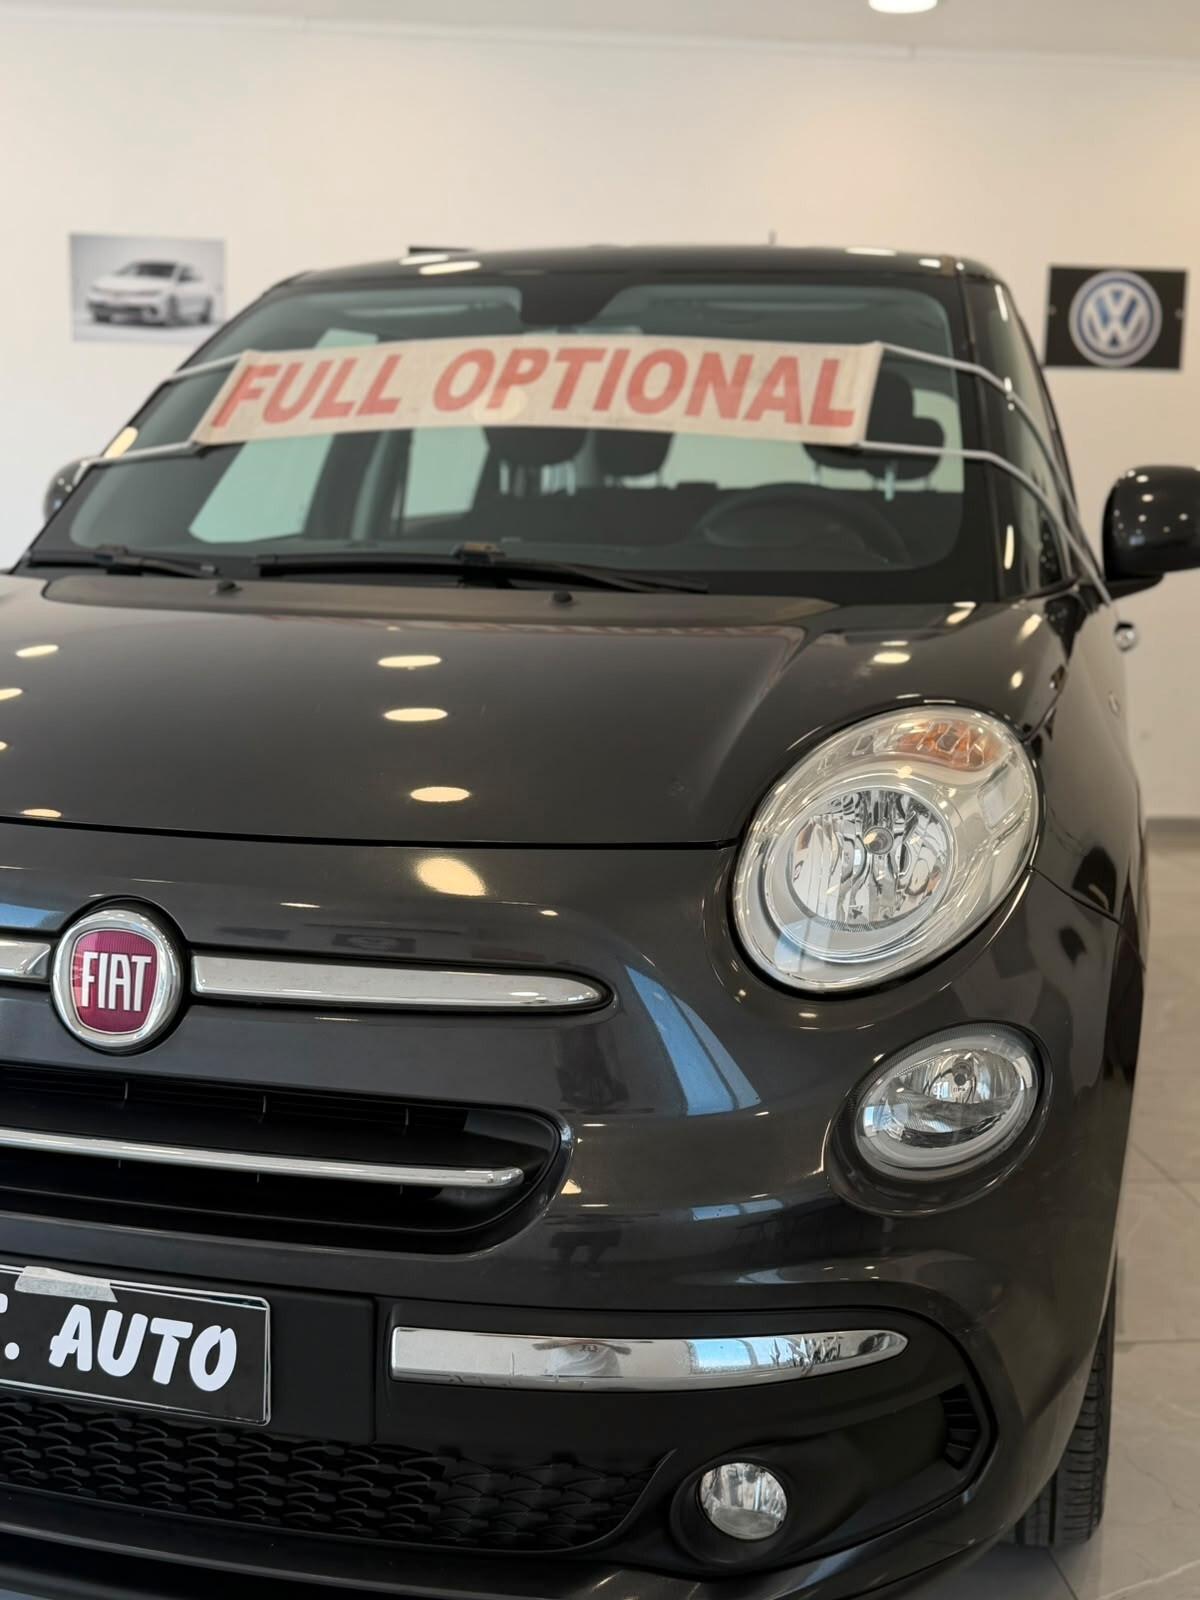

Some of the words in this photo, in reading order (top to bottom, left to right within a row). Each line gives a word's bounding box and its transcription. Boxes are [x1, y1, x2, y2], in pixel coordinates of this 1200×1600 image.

[211, 353, 403, 428] FULL
[433, 347, 855, 427] OPTIONAL
[81, 951, 152, 1012] FIAT
[49, 1304, 237, 1391] AUTO
